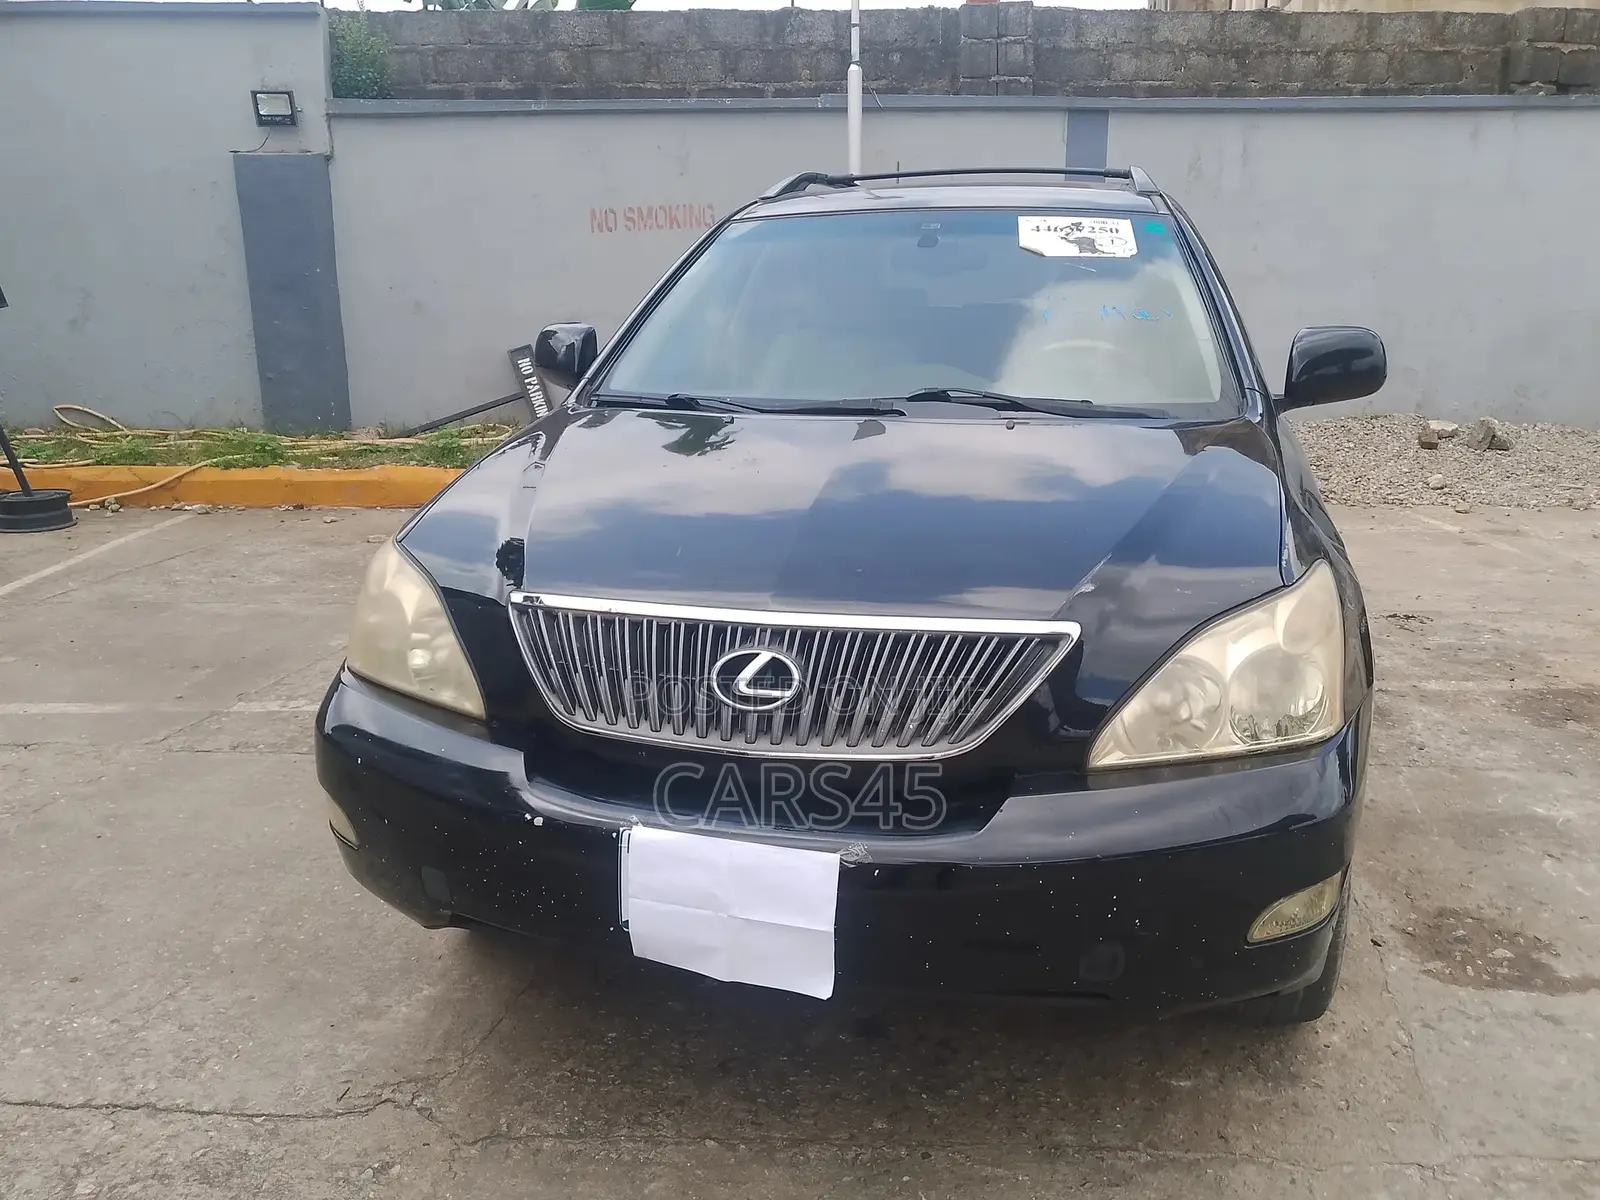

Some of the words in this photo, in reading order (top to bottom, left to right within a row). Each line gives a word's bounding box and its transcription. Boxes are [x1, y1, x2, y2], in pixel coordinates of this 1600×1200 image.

[589, 205, 618, 233] NO
[622, 202, 716, 232] SMOKING
[517, 357, 534, 375] NO
[524, 376, 549, 418] PARKIN
